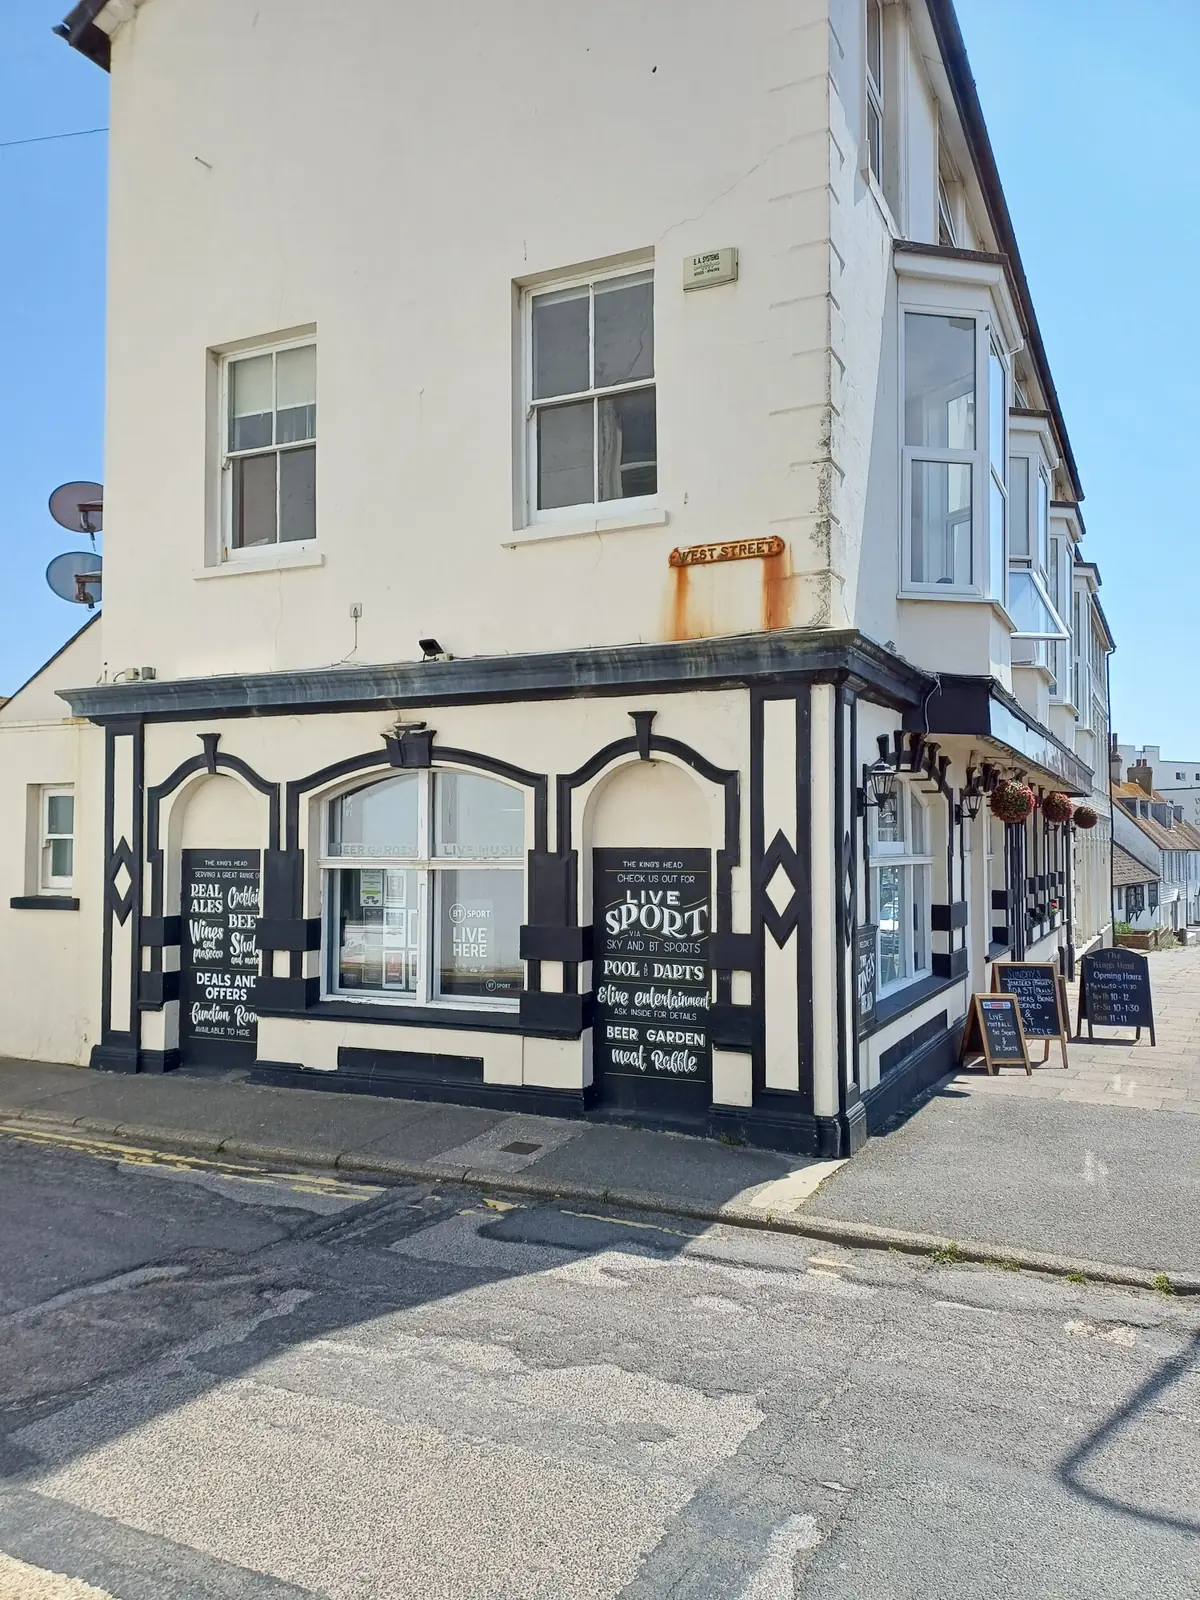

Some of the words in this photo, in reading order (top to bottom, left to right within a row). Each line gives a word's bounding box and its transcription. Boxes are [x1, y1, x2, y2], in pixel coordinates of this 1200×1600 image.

[679, 548, 716, 562] WEST
[720, 541, 774, 557] STREET
[662, 861, 684, 869] HEAD
[194, 871, 216, 879] SERVING
[239, 872, 254, 880] RANGE
[617, 873, 646, 883] CHECK
[648, 874, 659, 883] US
[661, 875, 678, 884] OUT
[680, 875, 696, 884] FOR
[190, 883, 223, 899] REAL
[227, 885, 260, 910] Cocktai
[626, 889, 681, 906] LIVE
[190, 899, 223, 914] ALES
[466, 909, 491, 919] SPORT
[228, 913, 257, 929] BEE
[605, 903, 709, 940] SPORT
[452, 926, 488, 944] LIVE
[452, 943, 488, 958] HERE
[606, 939, 623, 950] SKY
[627, 941, 645, 951] AND
[649, 941, 659, 952] BT
[664, 942, 701, 953] SPORTS
[603, 960, 640, 977] POOL
[653, 963, 705, 981] DARTS
[1093, 971, 1122, 981] Opening
[1122, 972, 1143, 981] Hours
[196, 972, 231, 986] DEALS
[205, 986, 247, 1001] OFFERS
[630, 1009, 652, 1018] INSIDE
[669, 1011, 697, 1021] DETAILS
[988, 1013, 1004, 1021] LIVE
[1024, 1009, 1032, 1018] &
[195, 1026, 225, 1035] AVAILABLE
[226, 1028, 236, 1036] TO
[236, 1028, 251, 1037] HIRE
[606, 1026, 639, 1041] BEER
[646, 1029, 706, 1047] GARDEN
[650, 1048, 699, 1074] Raffle
